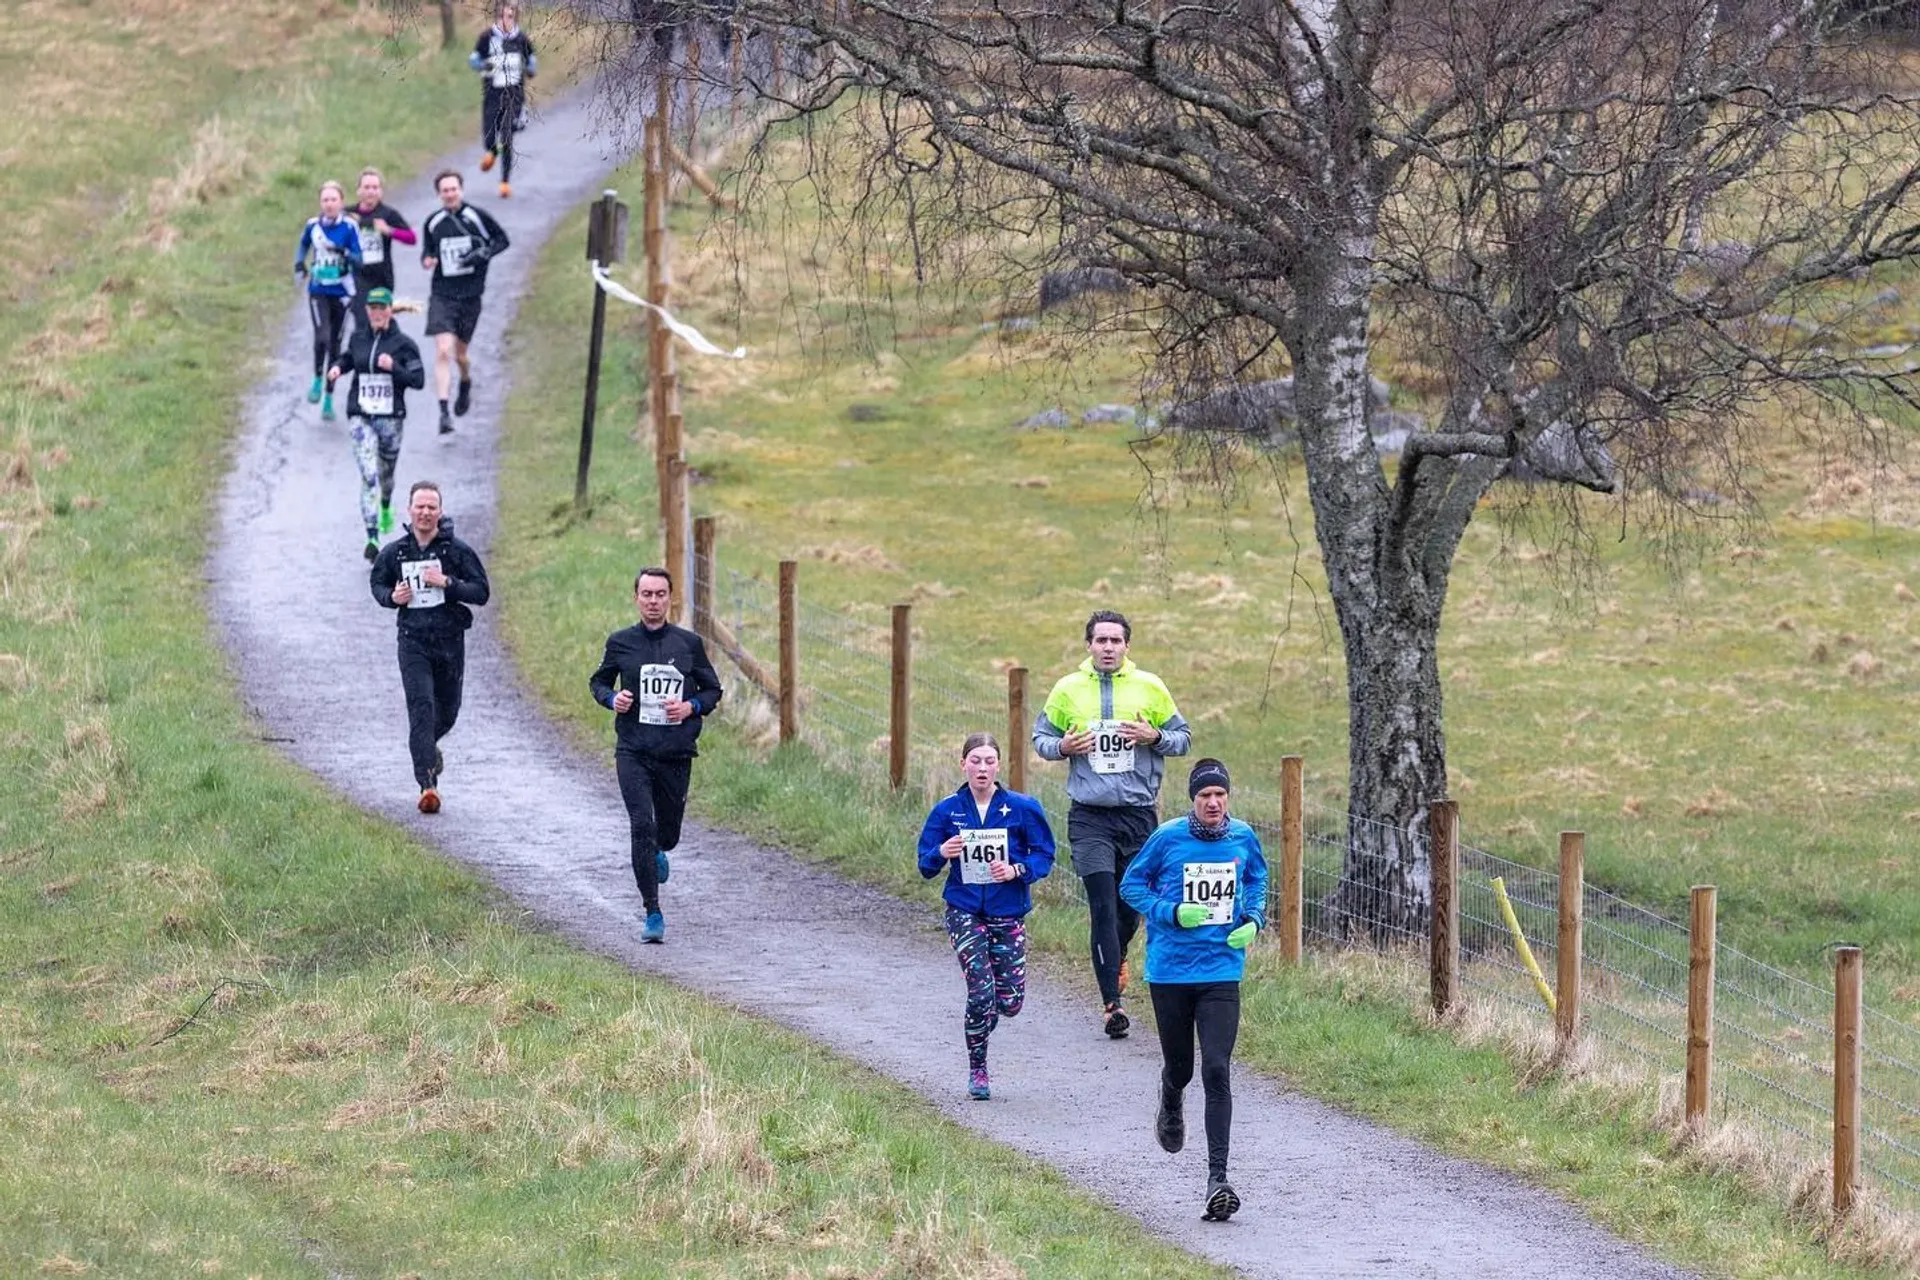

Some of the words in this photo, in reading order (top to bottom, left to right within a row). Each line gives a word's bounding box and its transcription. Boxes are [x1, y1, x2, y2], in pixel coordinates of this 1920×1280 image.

[361, 385, 392, 398] 1378
[642, 677, 682, 695] 1077
[962, 844, 1005, 863] 1461
[1185, 880, 1235, 902] 1044
